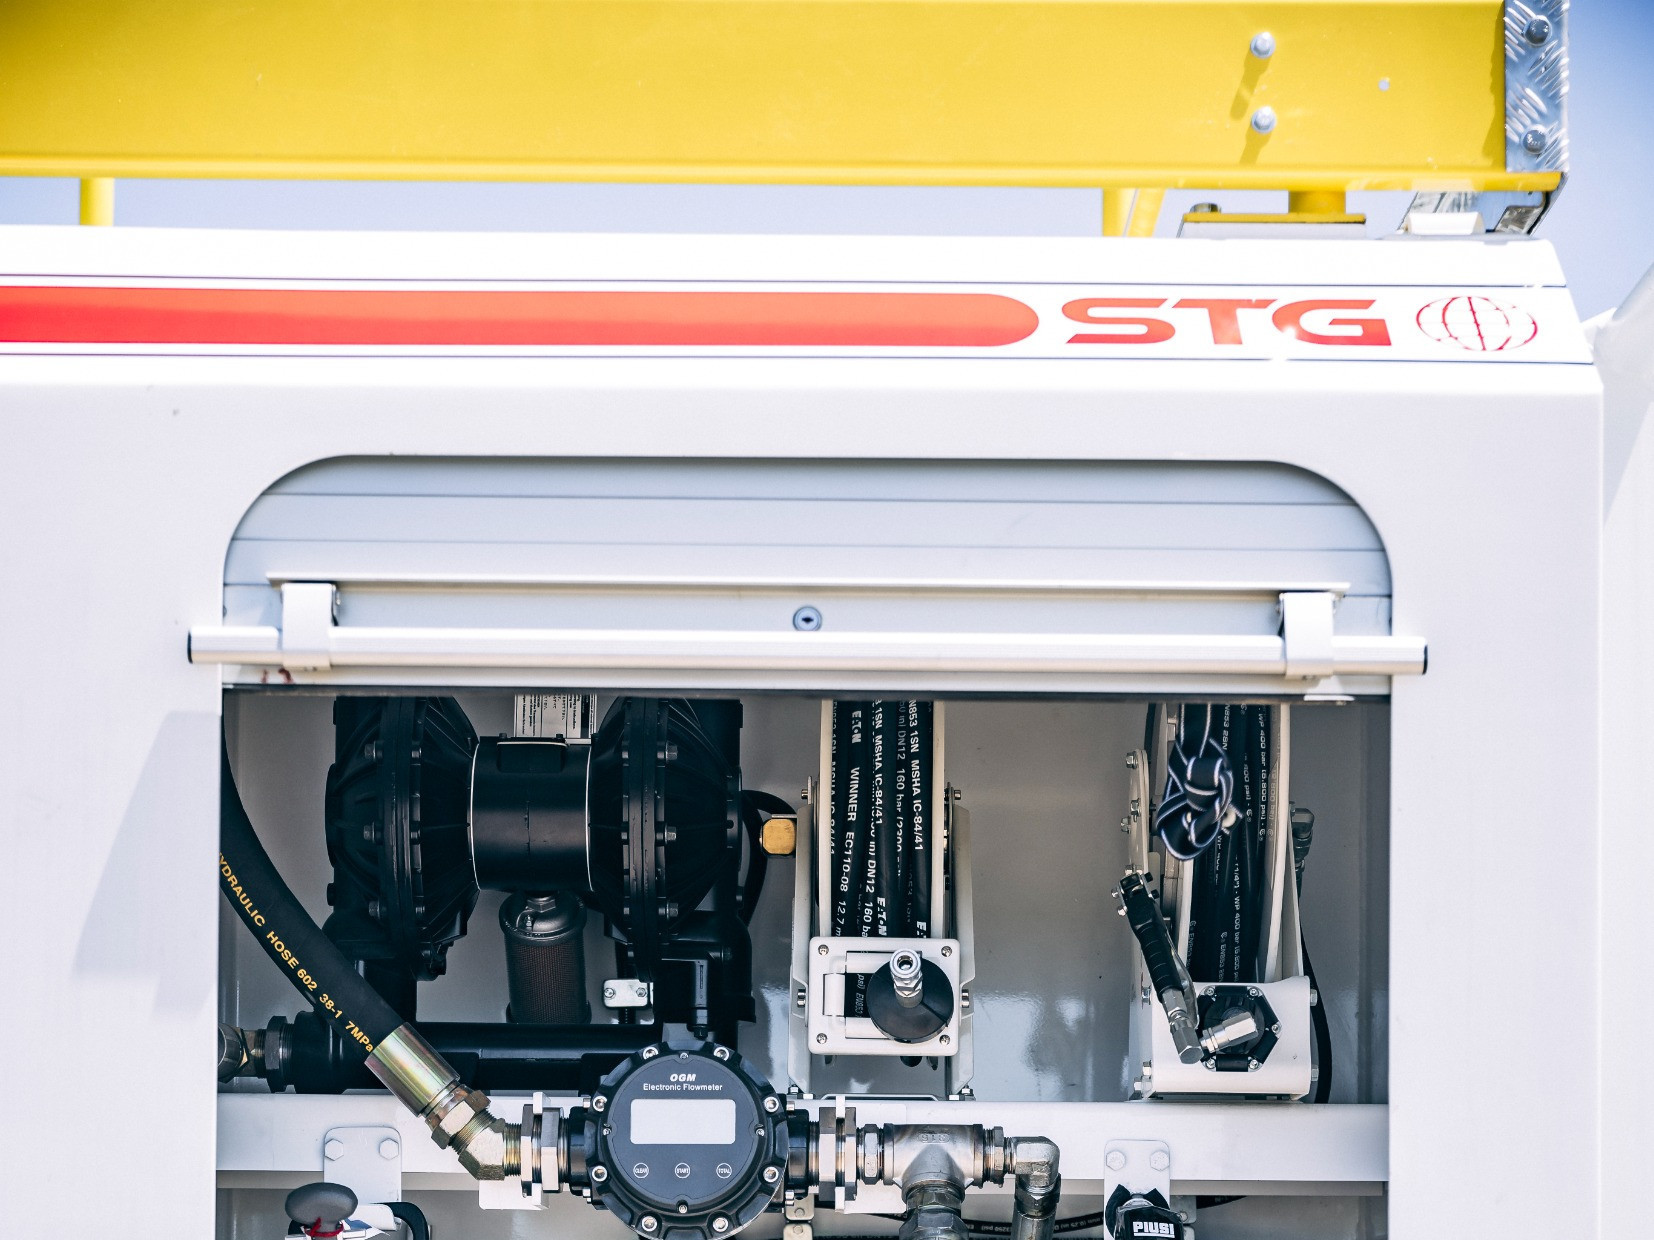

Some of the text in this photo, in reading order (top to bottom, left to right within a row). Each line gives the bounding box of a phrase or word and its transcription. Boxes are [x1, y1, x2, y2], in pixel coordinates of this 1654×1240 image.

[1061, 297, 1392, 346] STG
[897, 731, 906, 760] DN12
[896, 768, 905, 790] 160
[908, 700, 924, 850] N853 1SN MSHA IC-84/41
[847, 767, 860, 822] WINNER
[875, 773, 883, 824] IC-84/41
[840, 831, 855, 892] EC110-08
[866, 860, 876, 893] DN12
[837, 901, 847, 925] 12.7
[863, 902, 873, 923] 160
[862, 925, 871, 938] ba
[267, 931, 299, 969] HOSE
[297, 968, 318, 991] 602
[319, 993, 343, 1019] 38-1
[345, 1021, 374, 1053] 7MPa
[643, 1083, 723, 1091] Electronic Flowmeter
[669, 1073, 697, 1082] OGM
[1132, 1221, 1175, 1235] PIUSI
